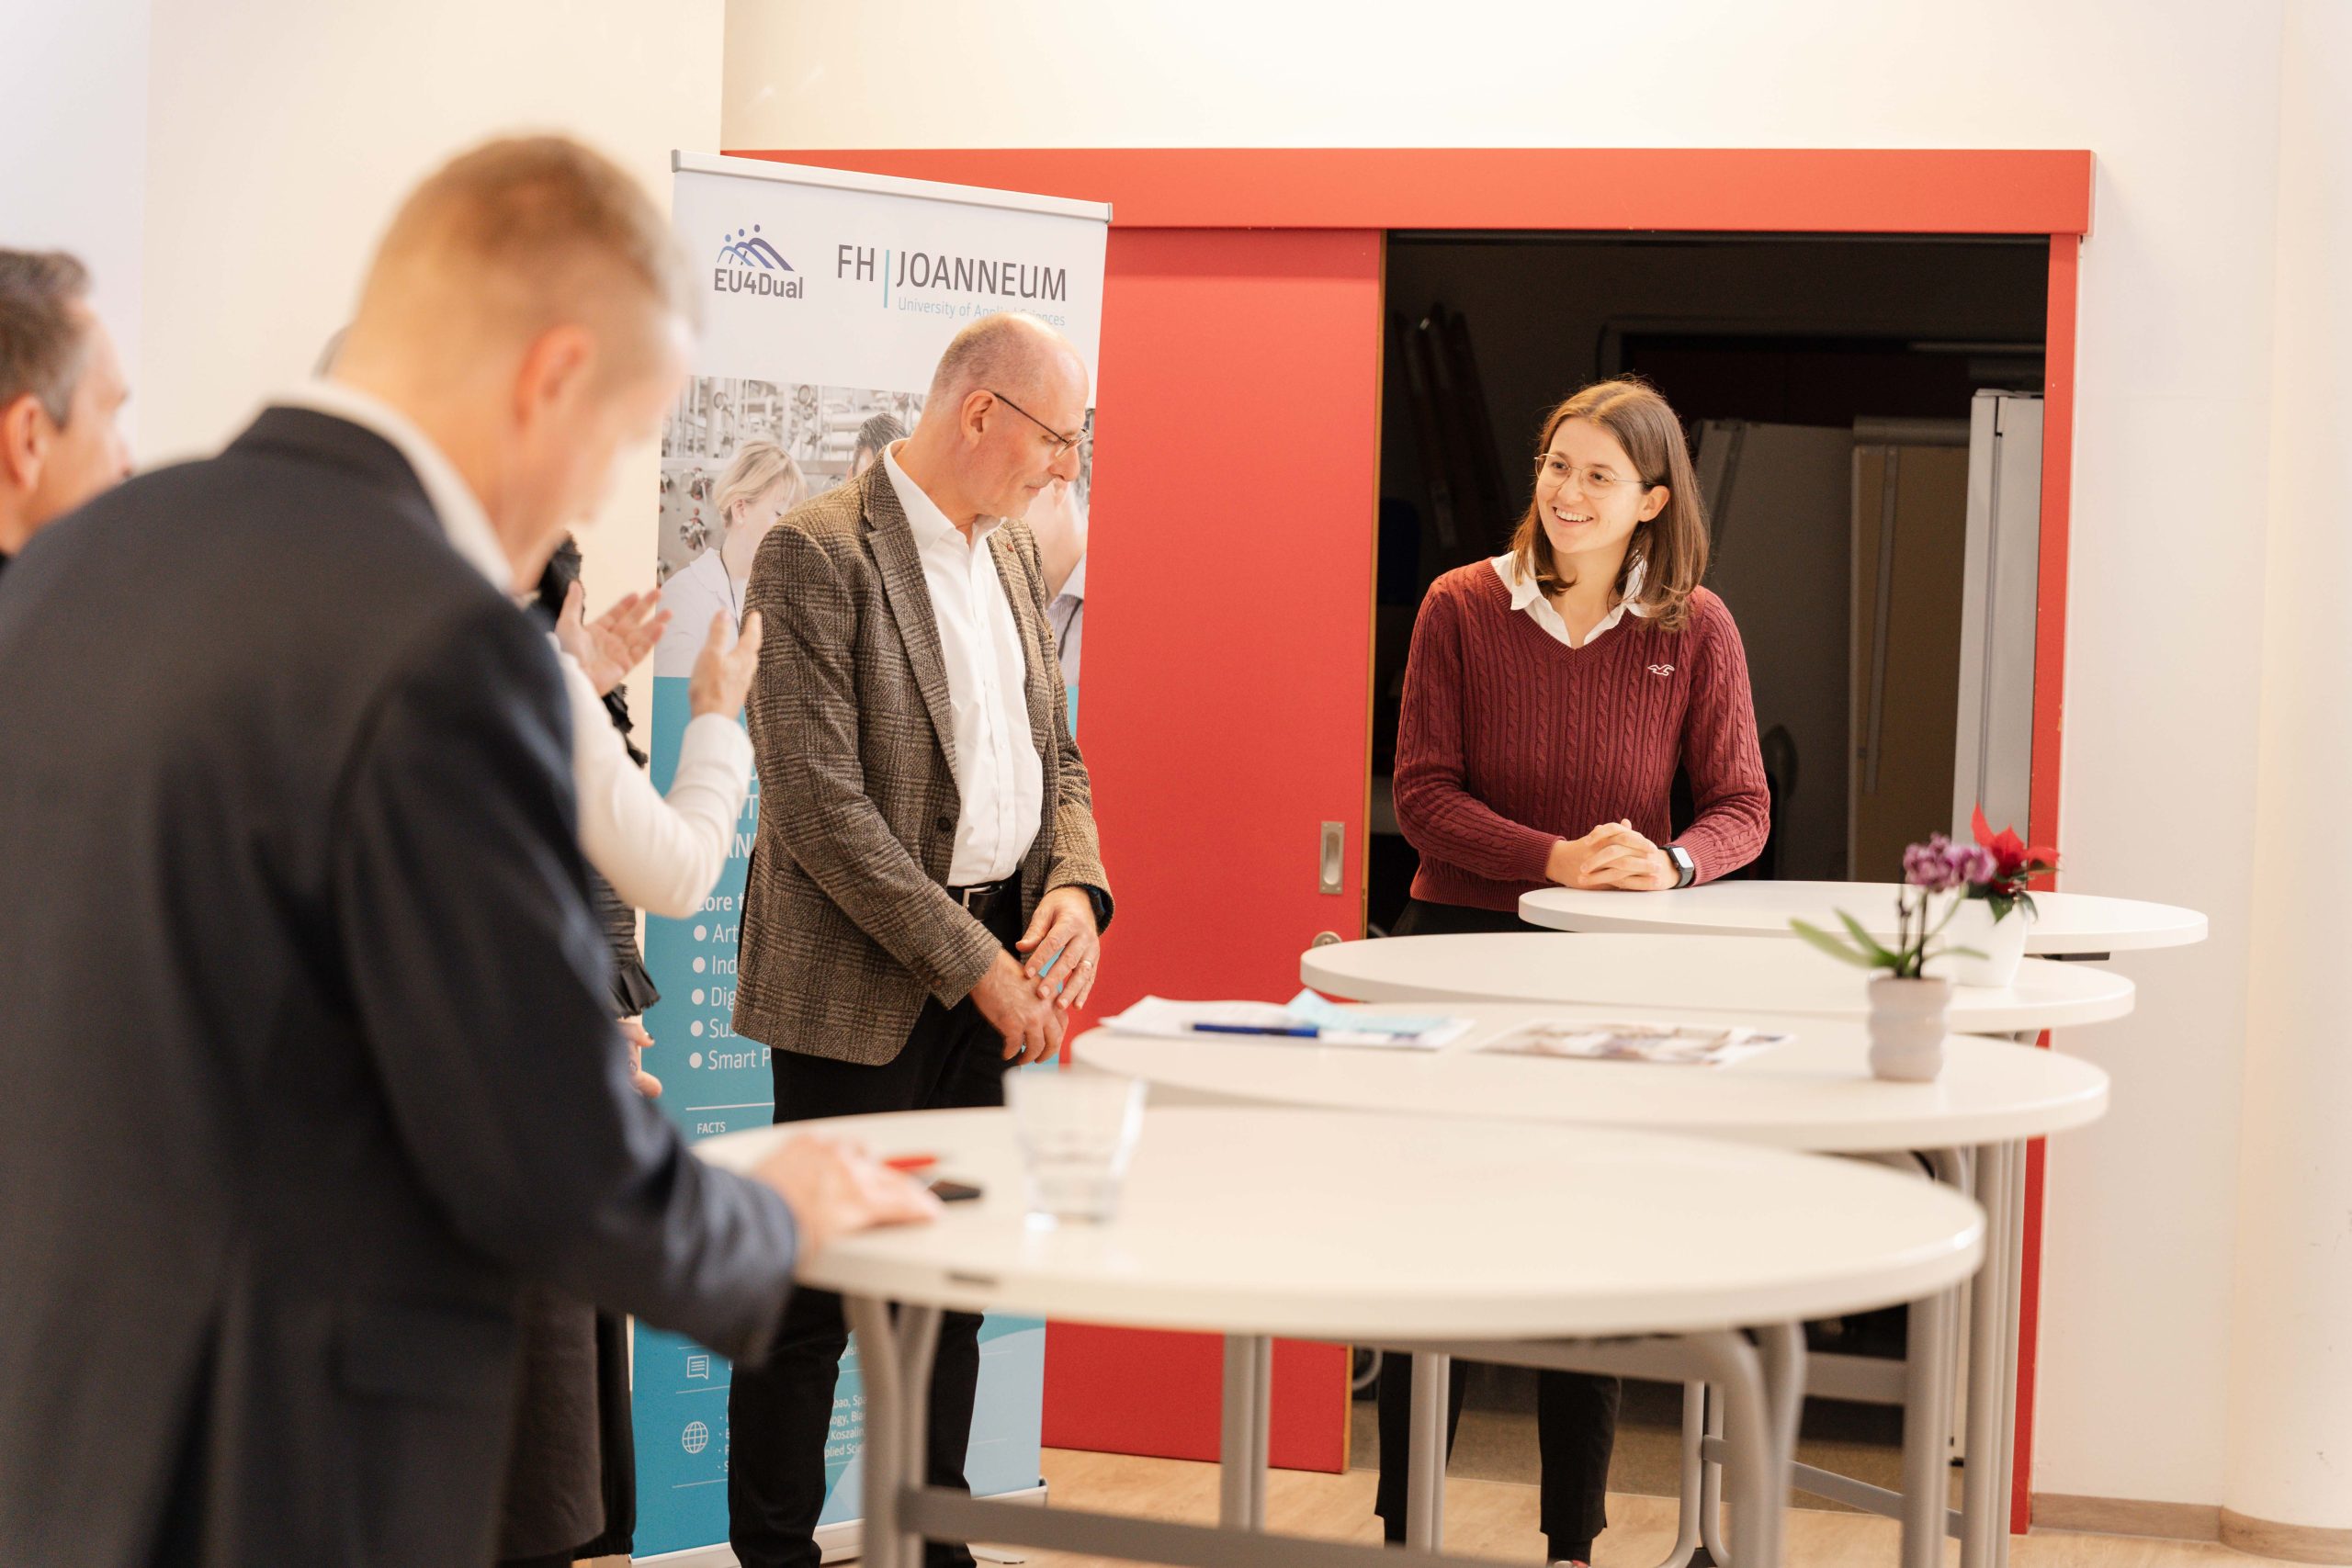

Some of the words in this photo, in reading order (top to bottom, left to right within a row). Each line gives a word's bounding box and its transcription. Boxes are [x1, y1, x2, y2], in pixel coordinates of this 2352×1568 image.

[714, 267, 803, 299] EU4Dual
[837, 244, 875, 282] FH
[897, 251, 1067, 301] JOANNEUM
[899, 297, 954, 319] University
[959, 302, 971, 317] of
[712, 923, 740, 943] Art
[712, 953, 738, 975] Ind
[710, 987, 737, 1011] Dig
[707, 1048, 756, 1070] Smart
[696, 1121, 727, 1134] FACTS
